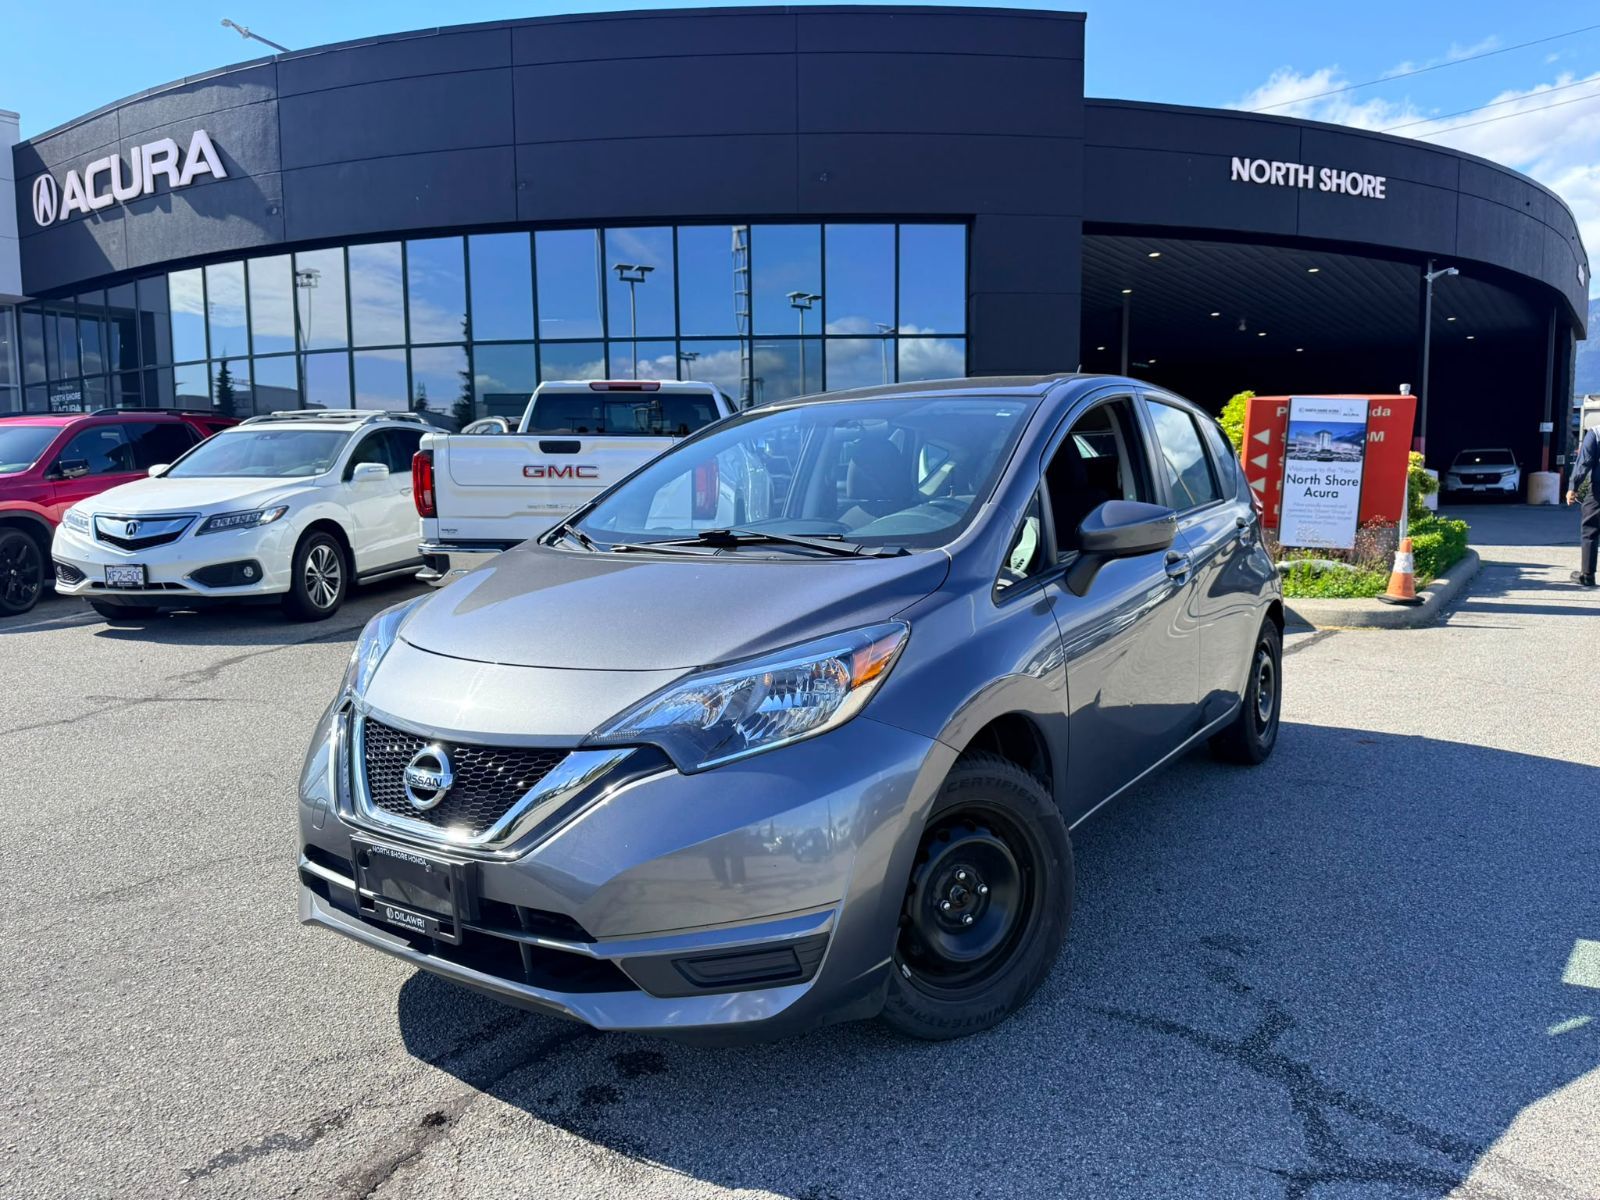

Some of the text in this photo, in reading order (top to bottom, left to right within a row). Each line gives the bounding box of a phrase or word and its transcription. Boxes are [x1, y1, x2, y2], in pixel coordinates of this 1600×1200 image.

[59, 129, 228, 220] ACURA
[1231, 157, 1386, 199] NORTH SHORE
[522, 465, 599, 479] GMC
[1286, 474, 1359, 487] North Shore
[1304, 487, 1339, 498] Acura
[406, 771, 443, 787] NISSAN
[372, 845, 427, 866] NORTH SHORE HONDA
[394, 911, 425, 928] DILAWRI
